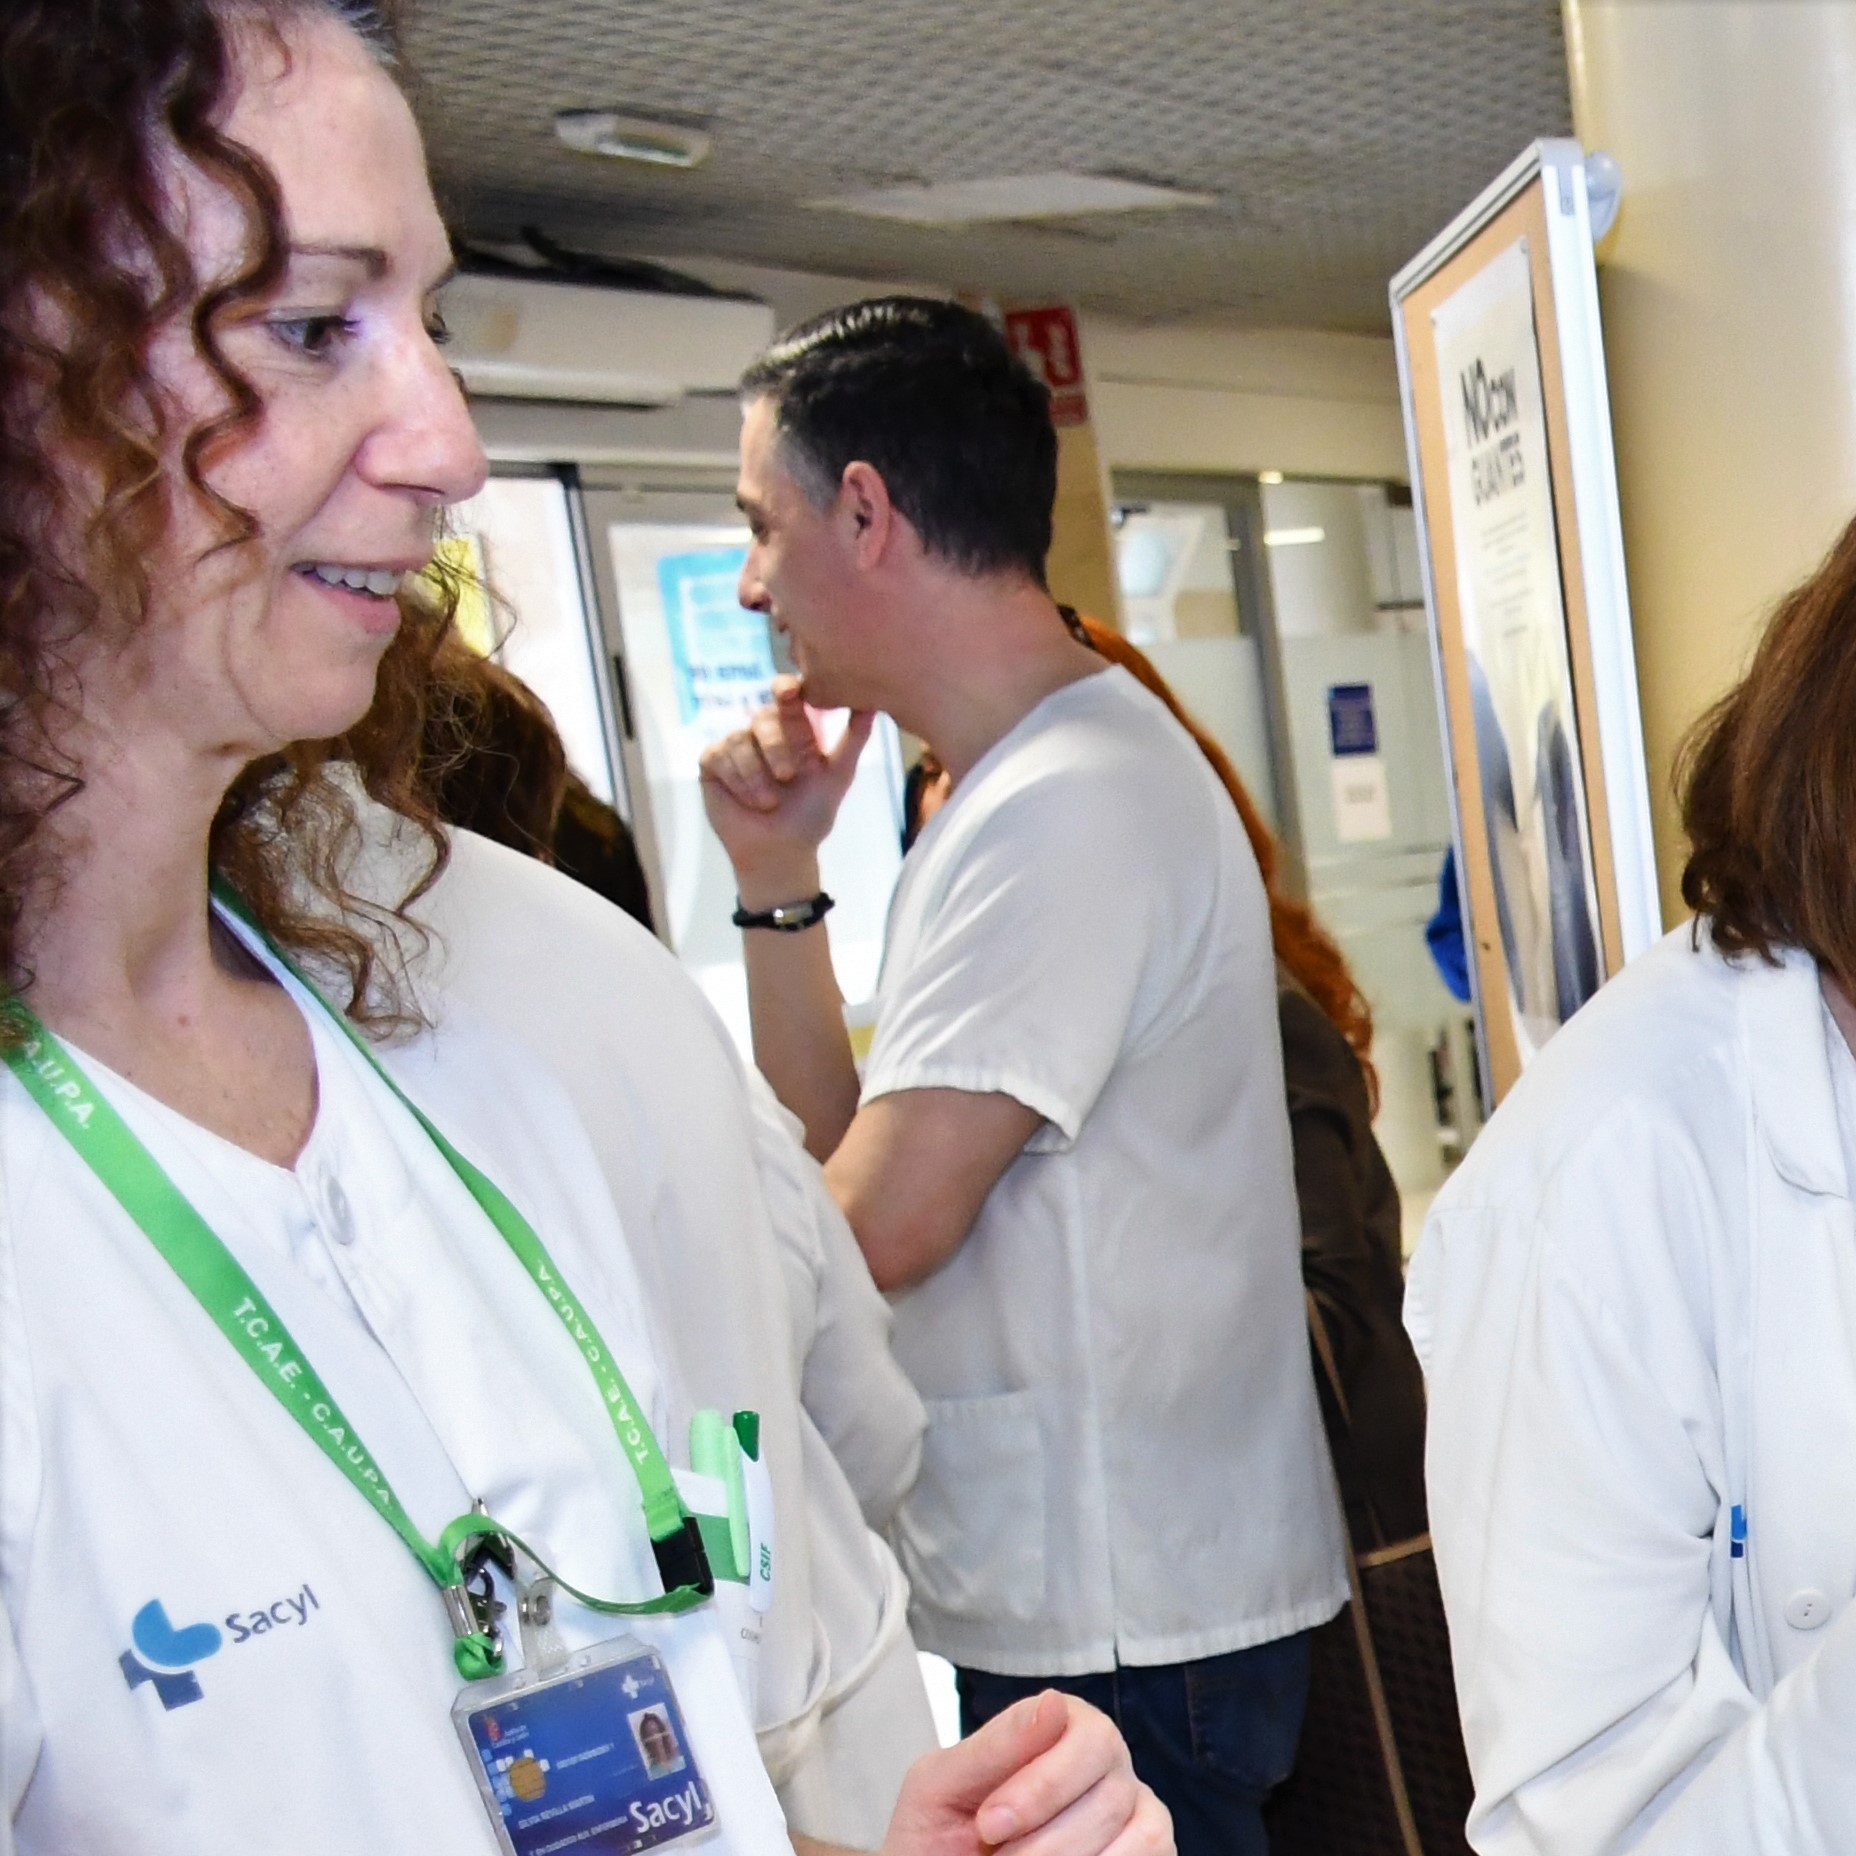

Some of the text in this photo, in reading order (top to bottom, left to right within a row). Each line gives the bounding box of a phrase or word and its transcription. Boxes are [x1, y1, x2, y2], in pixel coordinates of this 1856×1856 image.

[232, 1296, 303, 1389] T.C.A.E.
[760, 1542, 772, 1582] CSIF
[225, 1584, 320, 1644] Sacyl
[629, 1780, 702, 1834] Sacyl
